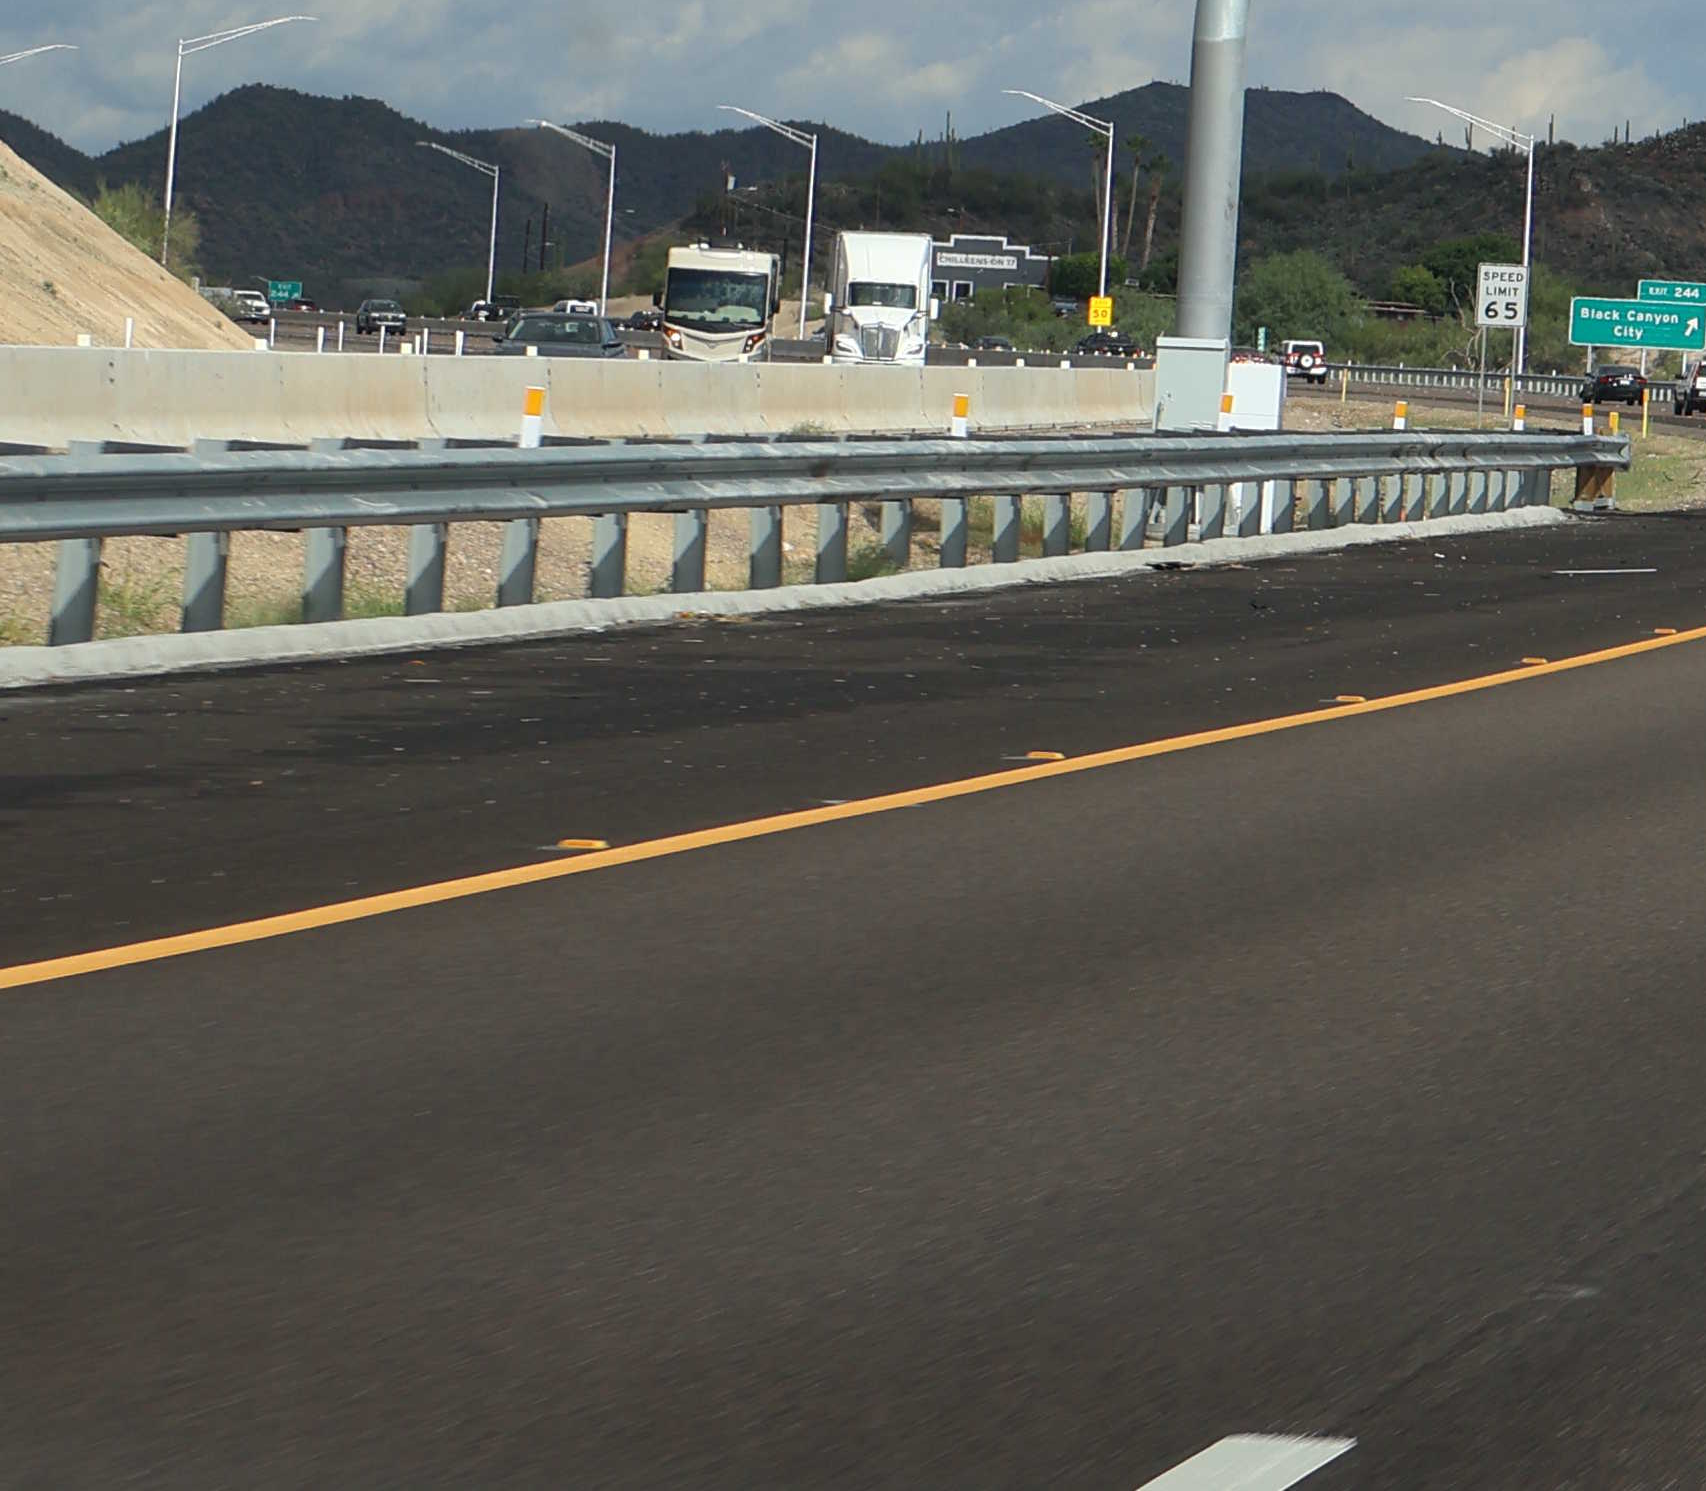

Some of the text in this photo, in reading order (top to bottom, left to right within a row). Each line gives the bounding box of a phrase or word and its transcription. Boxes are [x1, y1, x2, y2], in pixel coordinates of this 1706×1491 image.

[1483, 271, 1524, 282] SPEED
[1486, 286, 1519, 296] LIMIT
[1648, 286, 1700, 299] EXIT 244
[1485, 301, 1518, 320] 65
[1580, 307, 1679, 325] Black Canyon
[1613, 325, 1644, 341] City
